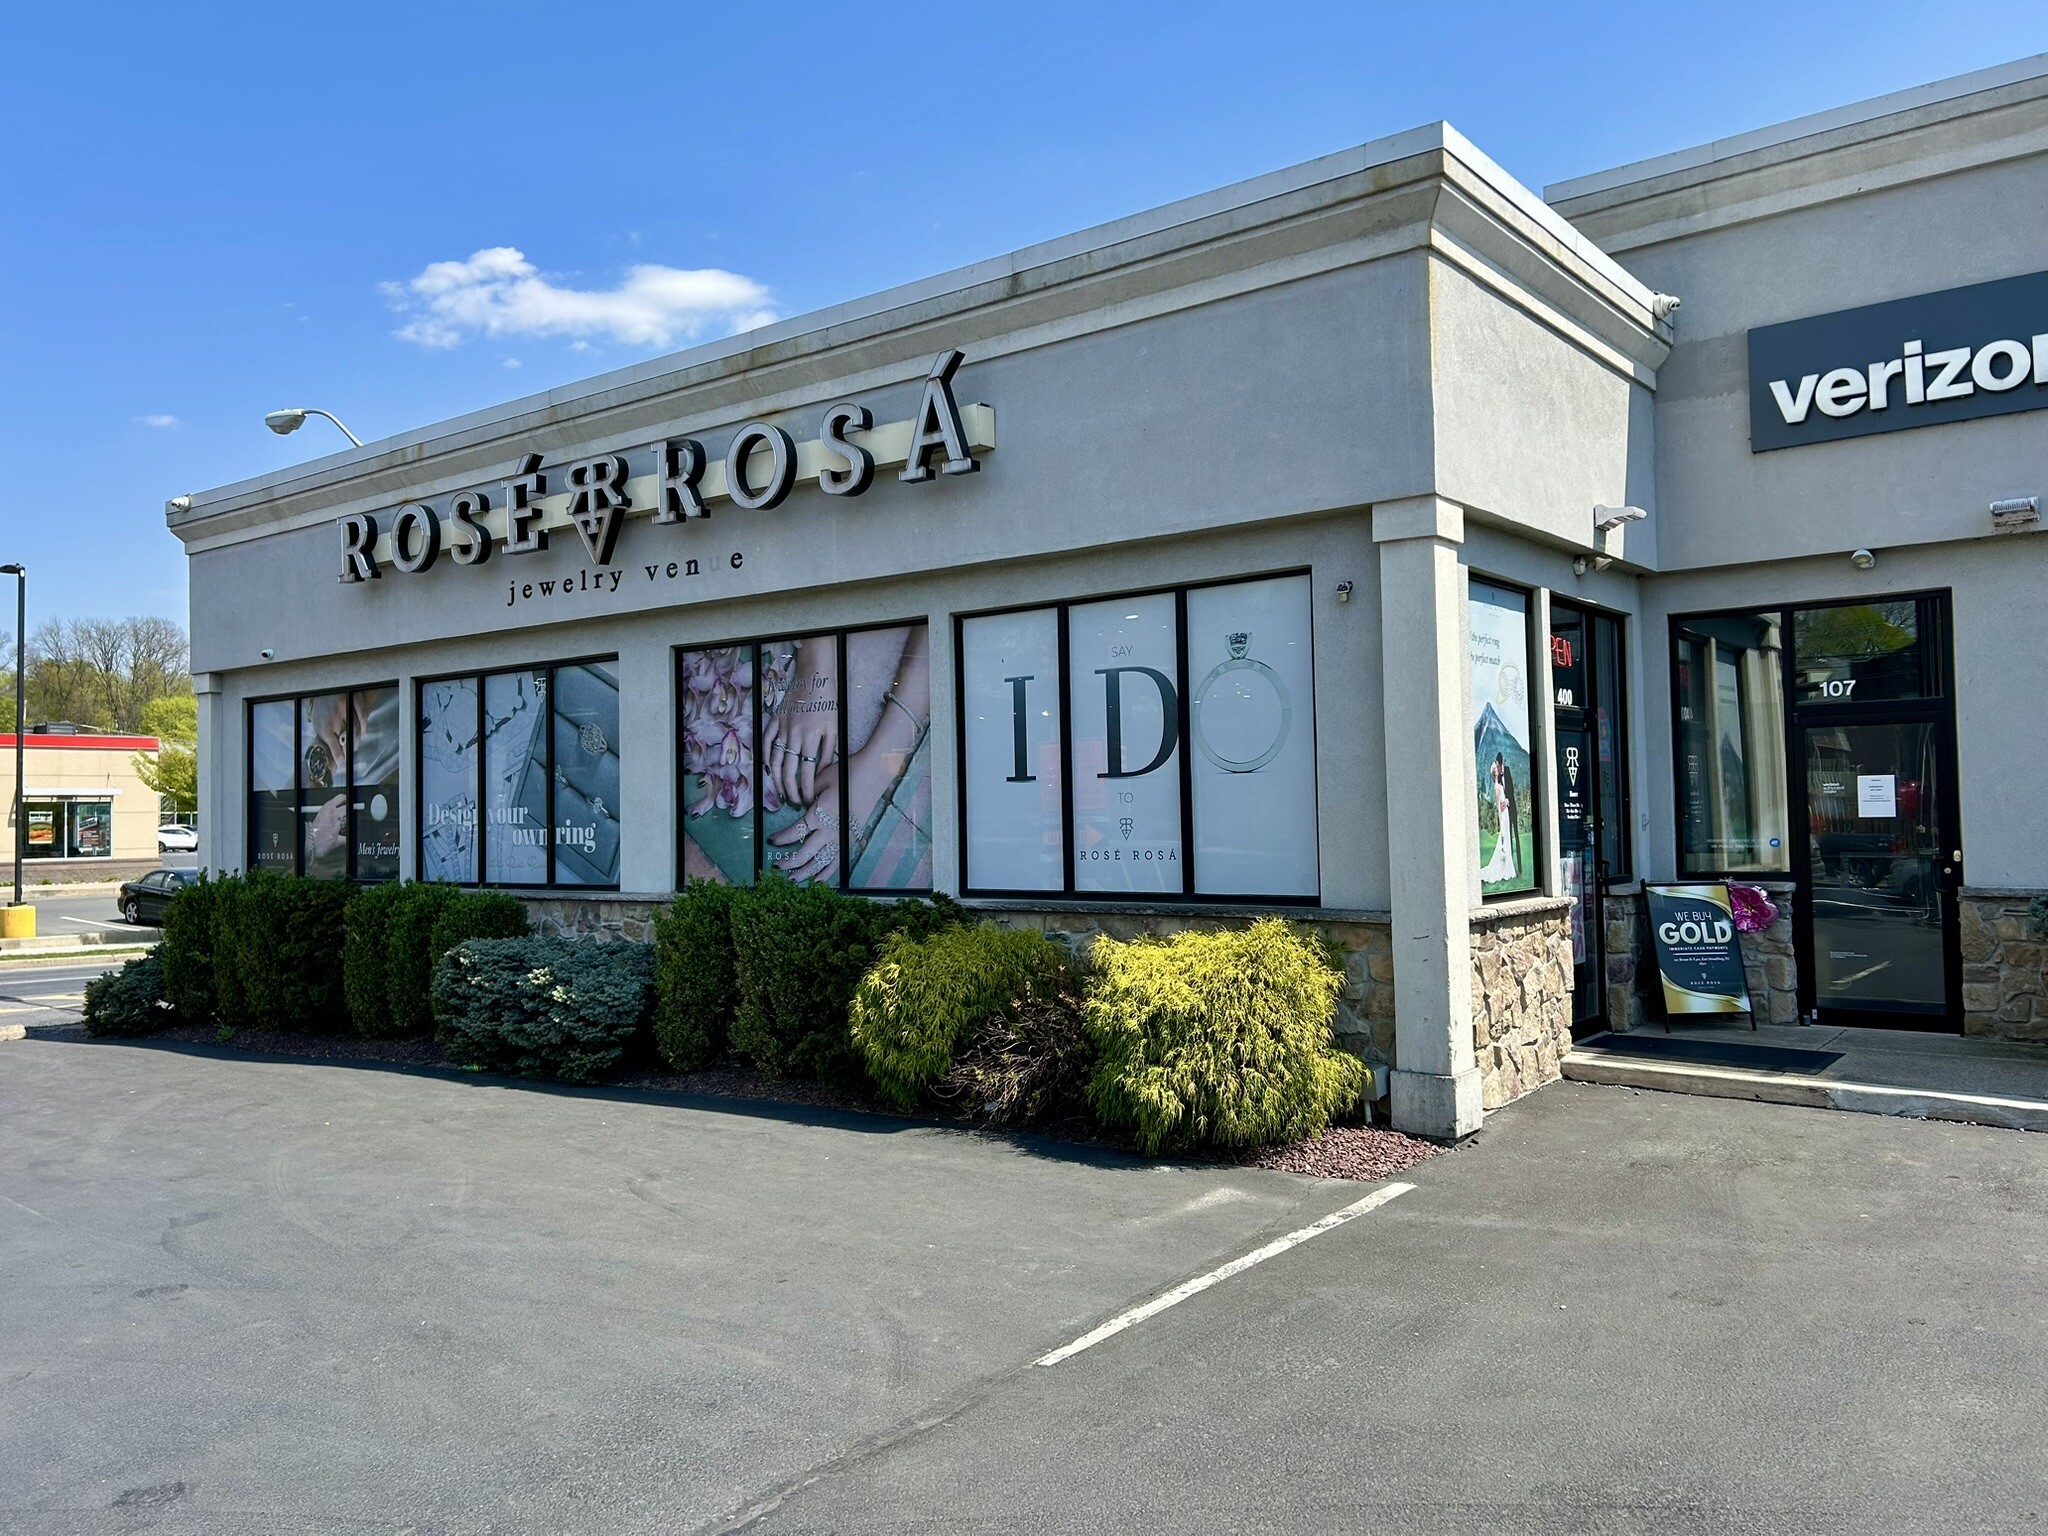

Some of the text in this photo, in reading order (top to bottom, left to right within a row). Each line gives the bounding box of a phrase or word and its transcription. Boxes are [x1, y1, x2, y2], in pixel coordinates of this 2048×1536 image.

[336, 451, 550, 583] ROSÉ
[650, 348, 980, 525] ROSÁ
[507, 570, 623, 606] jewelry
[1110, 644, 1134, 658] SAY
[808, 671, 829, 695] for
[1819, 680, 1856, 697] 107
[1557, 687, 1573, 706] 400
[1118, 792, 1134, 803] TO
[555, 819, 597, 853] ring
[358, 842, 401, 859] Men's Jewelry
[1080, 848, 1178, 861] ROSÉ ROSÁ
[1674, 911, 1712, 922] WE BUY
[1658, 921, 1732, 945] GOLD
